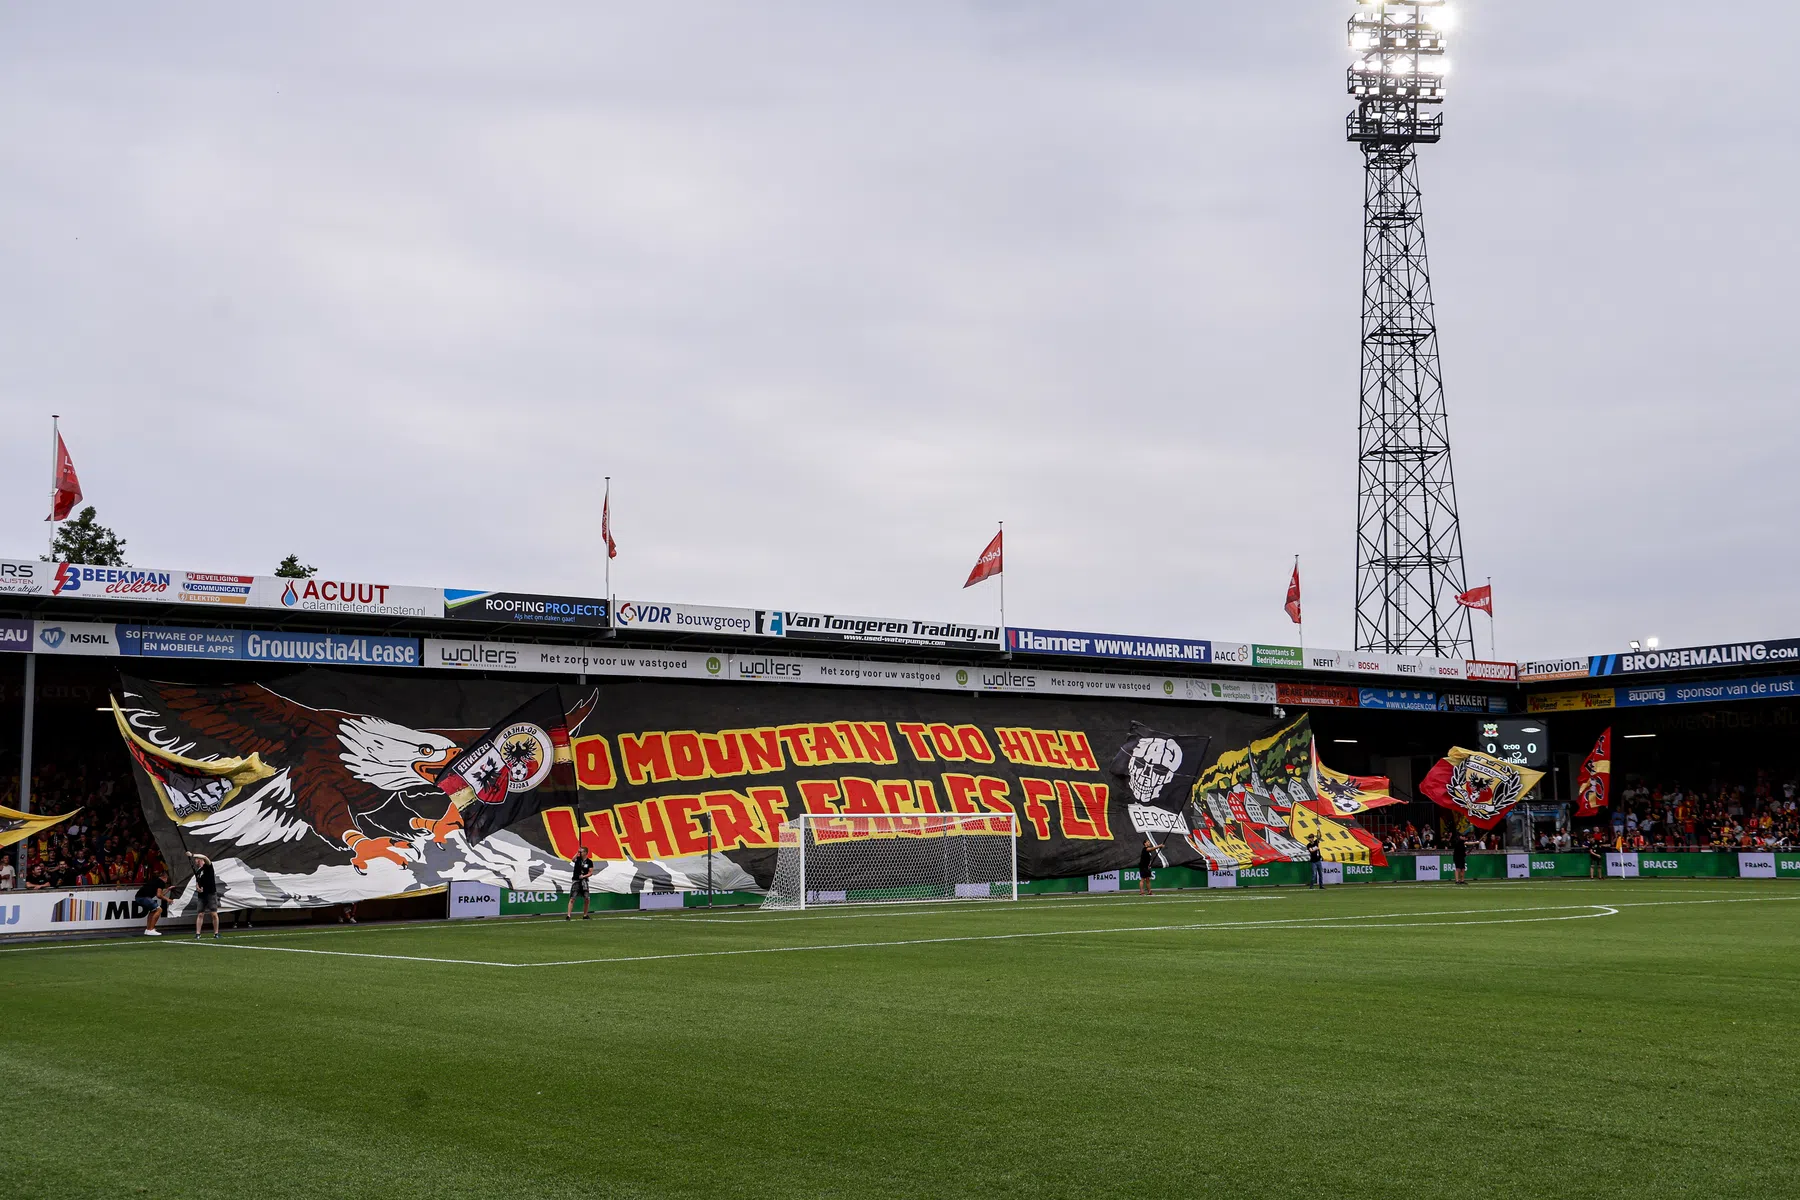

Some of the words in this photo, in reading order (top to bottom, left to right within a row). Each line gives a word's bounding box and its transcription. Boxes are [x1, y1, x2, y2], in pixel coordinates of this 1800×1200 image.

[83, 568, 170, 586] BEEKMAN
[196, 574, 238, 583] BEVEILIGING
[105, 578, 167, 593] elektro
[192, 584, 245, 593] COMMUNICATIE
[303, 580, 390, 604] ACUUT
[189, 594, 220, 602] ELEKTRO
[302, 600, 426, 616] calamiteitendiensten.nl
[485, 599, 606, 617] ROOFINGPROJECTS
[637, 605, 672, 624] VDR
[676, 613, 751, 632] Bouwgroep
[785, 612, 820, 628] Van
[823, 615, 908, 634] Tongeren
[912, 621, 1000, 642] Trading.nl
[70, 633, 109, 644] MSML
[126, 630, 186, 641] SOFTWARE
[189, 633, 203, 641] OP
[206, 634, 234, 643] MAAT
[843, 634, 946, 646] www.used-waterpumps.com
[143, 642, 158, 651] EN
[160, 643, 205, 653] MOBIELE
[207, 645, 234, 654] APPS
[1018, 631, 1090, 653] Hamer
[1094, 639, 1206, 660] WWW.HAMER.NET
[1256, 647, 1289, 657] Accountants
[1290, 649, 1295, 657] &
[441, 644, 517, 664] wolters
[540, 653, 560, 663] Met
[564, 656, 589, 667] zorg
[593, 657, 617, 666] voor
[620, 659, 635, 667] uw
[639, 659, 688, 670] vastgoed
[1214, 651, 1236, 662] AACC
[1256, 656, 1302, 666] Bedrijfsadviseurs
[739, 658, 802, 676] wolters
[820, 666, 837, 675] Met
[840, 669, 860, 679] zorg
[885, 671, 898, 679] uw
[900, 671, 941, 682] vastgoed
[1313, 658, 1334, 668] NEFIT
[1358, 661, 1379, 671] BOSCH
[1397, 664, 1416, 673] NEFIT
[1438, 667, 1459, 676] BOSCH
[1526, 659, 1589, 674] Finovion.nl
[983, 671, 1036, 687] wolters
[1051, 678, 1065, 686] Met
[1067, 680, 1084, 689] zorg
[1117, 681, 1151, 692] vastgoed
[1279, 688, 1290, 696] WE
[1290, 689, 1303, 697] ARE
[1628, 690, 1666, 702] auping
[1676, 687, 1724, 700] sponsor
[1726, 685, 1748, 695] van
[1750, 682, 1767, 693] de
[1768, 680, 1795, 692] rust
[1386, 701, 1437, 711] WWW.VLAGGEN.COM
[1448, 694, 1487, 707] HEKKERT
[618, 721, 898, 785] MOUNTAIN
[896, 722, 996, 764] TOO
[995, 727, 1100, 772] HIGH
[1486, 742, 1497, 754] 0
[1527, 742, 1537, 754] 0
[541, 786, 800, 863] WHERE
[796, 773, 1022, 845] EAGLES
[1019, 776, 1114, 841] FLY
[1133, 811, 1187, 830] BERGEN
[508, 892, 558, 904] BRACES
[1124, 871, 1156, 881] BRAS
[1240, 868, 1269, 878] BRACES
[1346, 865, 1373, 875] BRACES
[1443, 863, 1467, 872] BRAS
[1532, 861, 1555, 870] BRACES
[1643, 860, 1678, 869] BRACES
